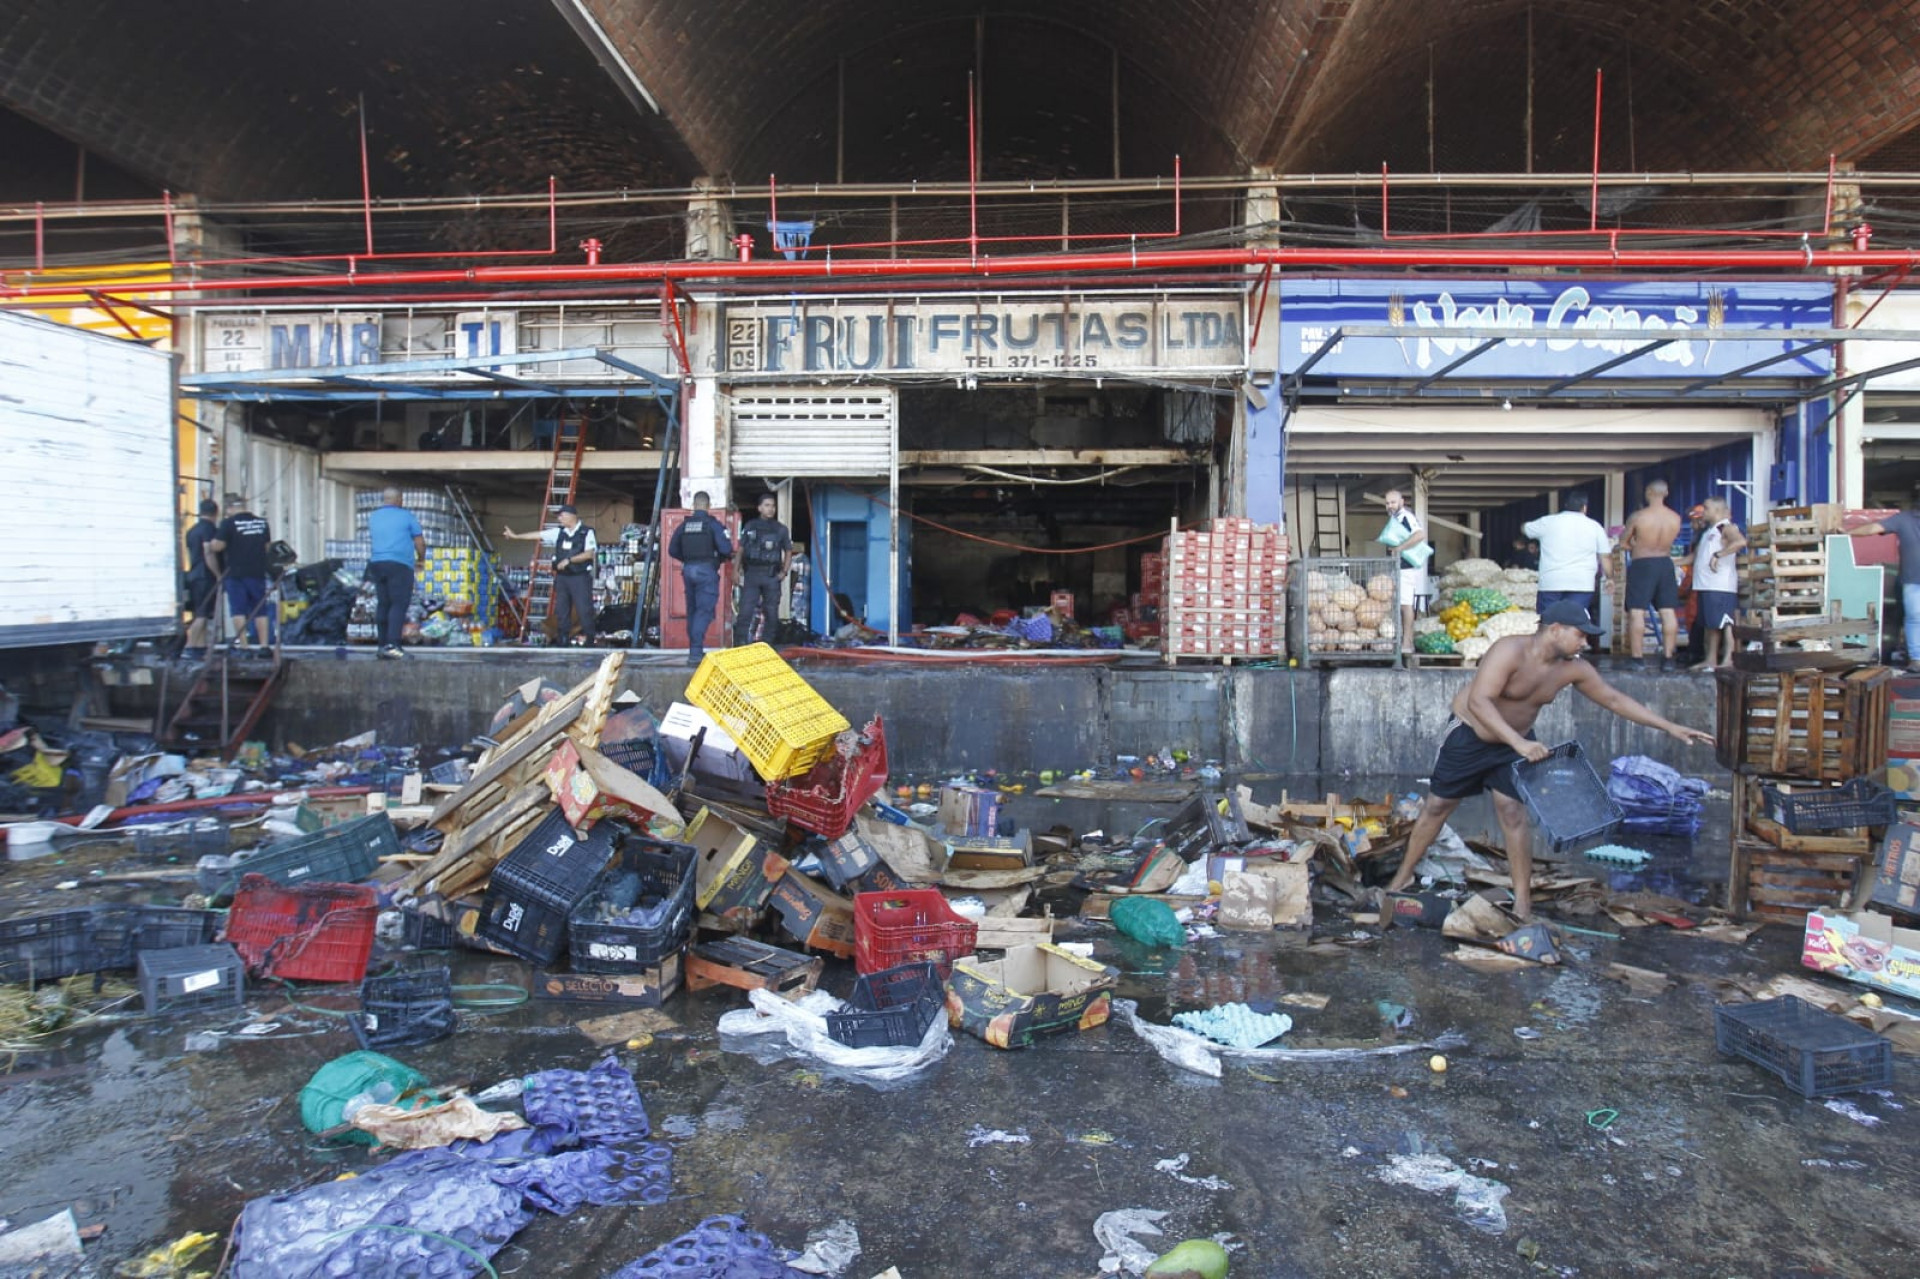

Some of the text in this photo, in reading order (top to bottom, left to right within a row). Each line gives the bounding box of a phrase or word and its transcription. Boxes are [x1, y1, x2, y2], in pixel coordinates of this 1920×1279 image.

[223, 330, 245, 347] 22
[929, 312, 1149, 350] FRUTAS
[1161, 311, 1241, 348] LTDA
